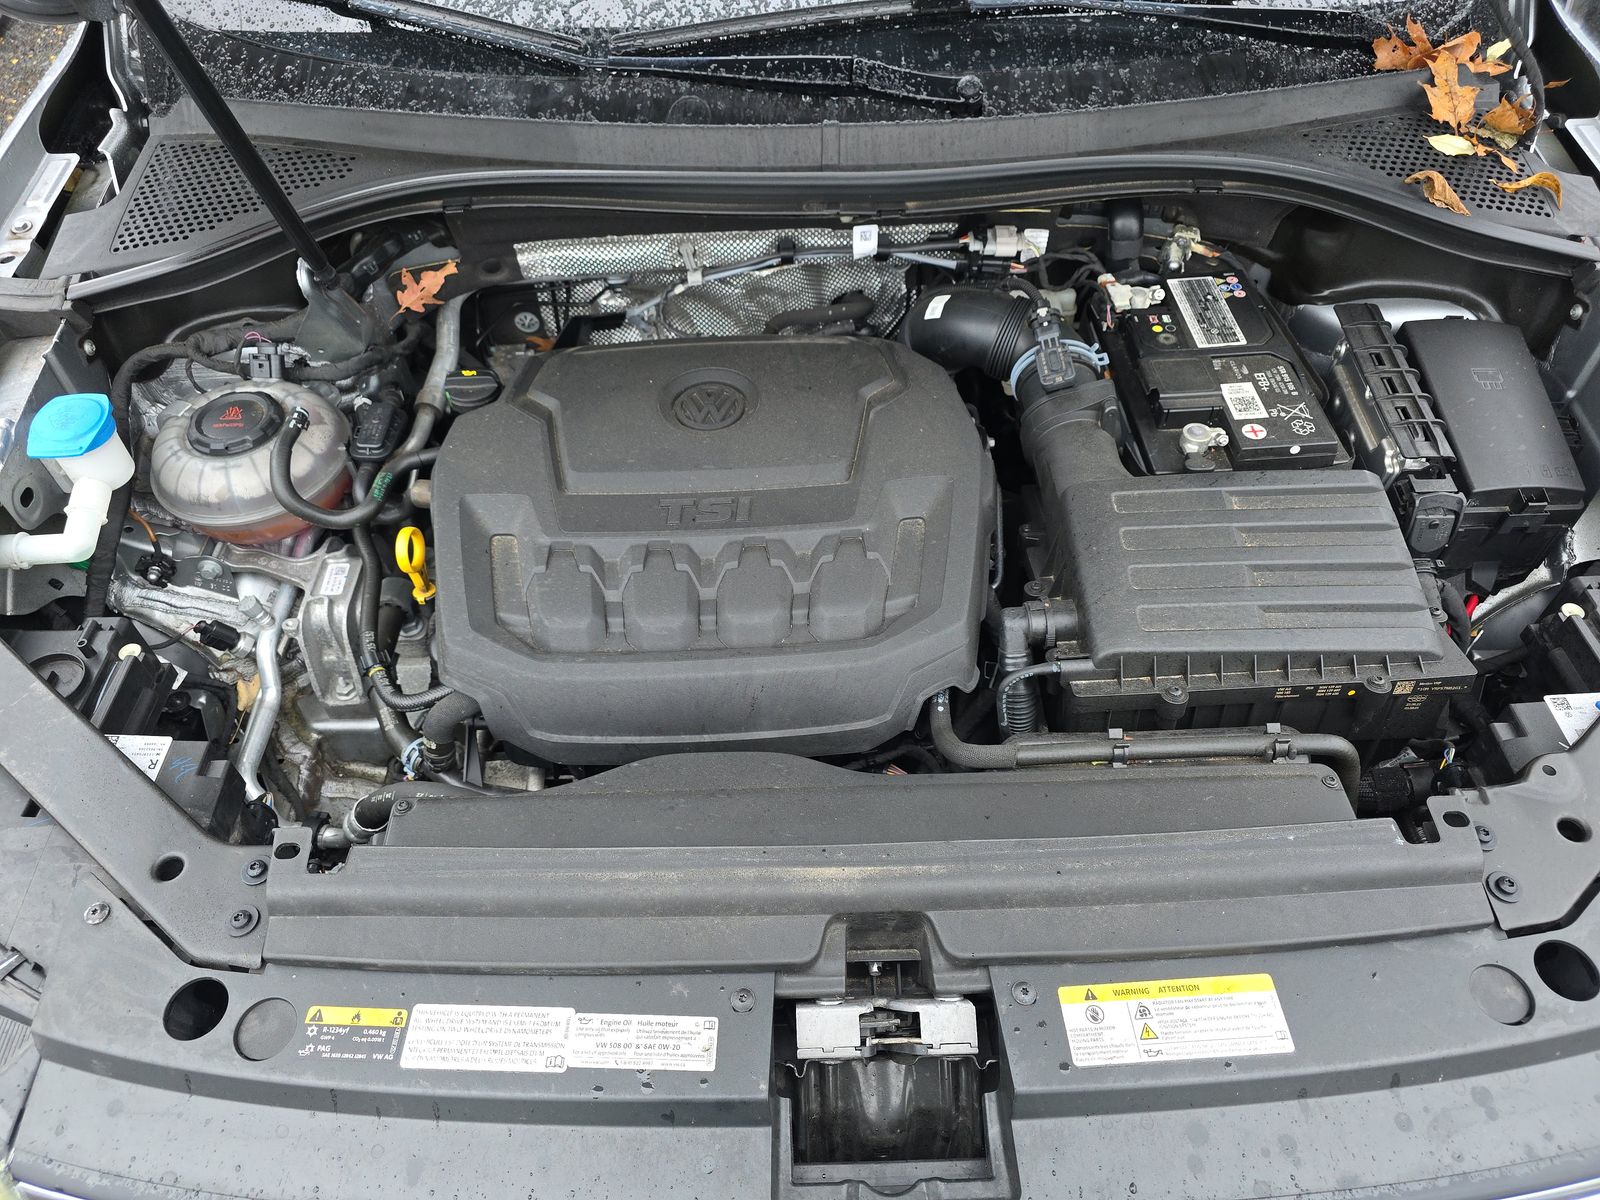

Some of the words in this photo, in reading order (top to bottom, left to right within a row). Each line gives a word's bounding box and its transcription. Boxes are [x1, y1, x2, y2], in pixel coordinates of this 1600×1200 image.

[1254, 373, 1270, 392] EFB+
[658, 495, 753, 526] TSI
[148, 759, 159, 770] R
[1112, 987, 1150, 997] WARNING
[1158, 984, 1200, 994] ATTENTION
[600, 1019, 622, 1027] Engine
[637, 1019, 654, 1027] Huile
[654, 1020, 679, 1028] moteur
[322, 1026, 350, 1036] R-1234yf
[316, 1044, 331, 1052] PAG
[657, 1043, 681, 1051] 0W-20
[384, 1053, 394, 1061] AG
